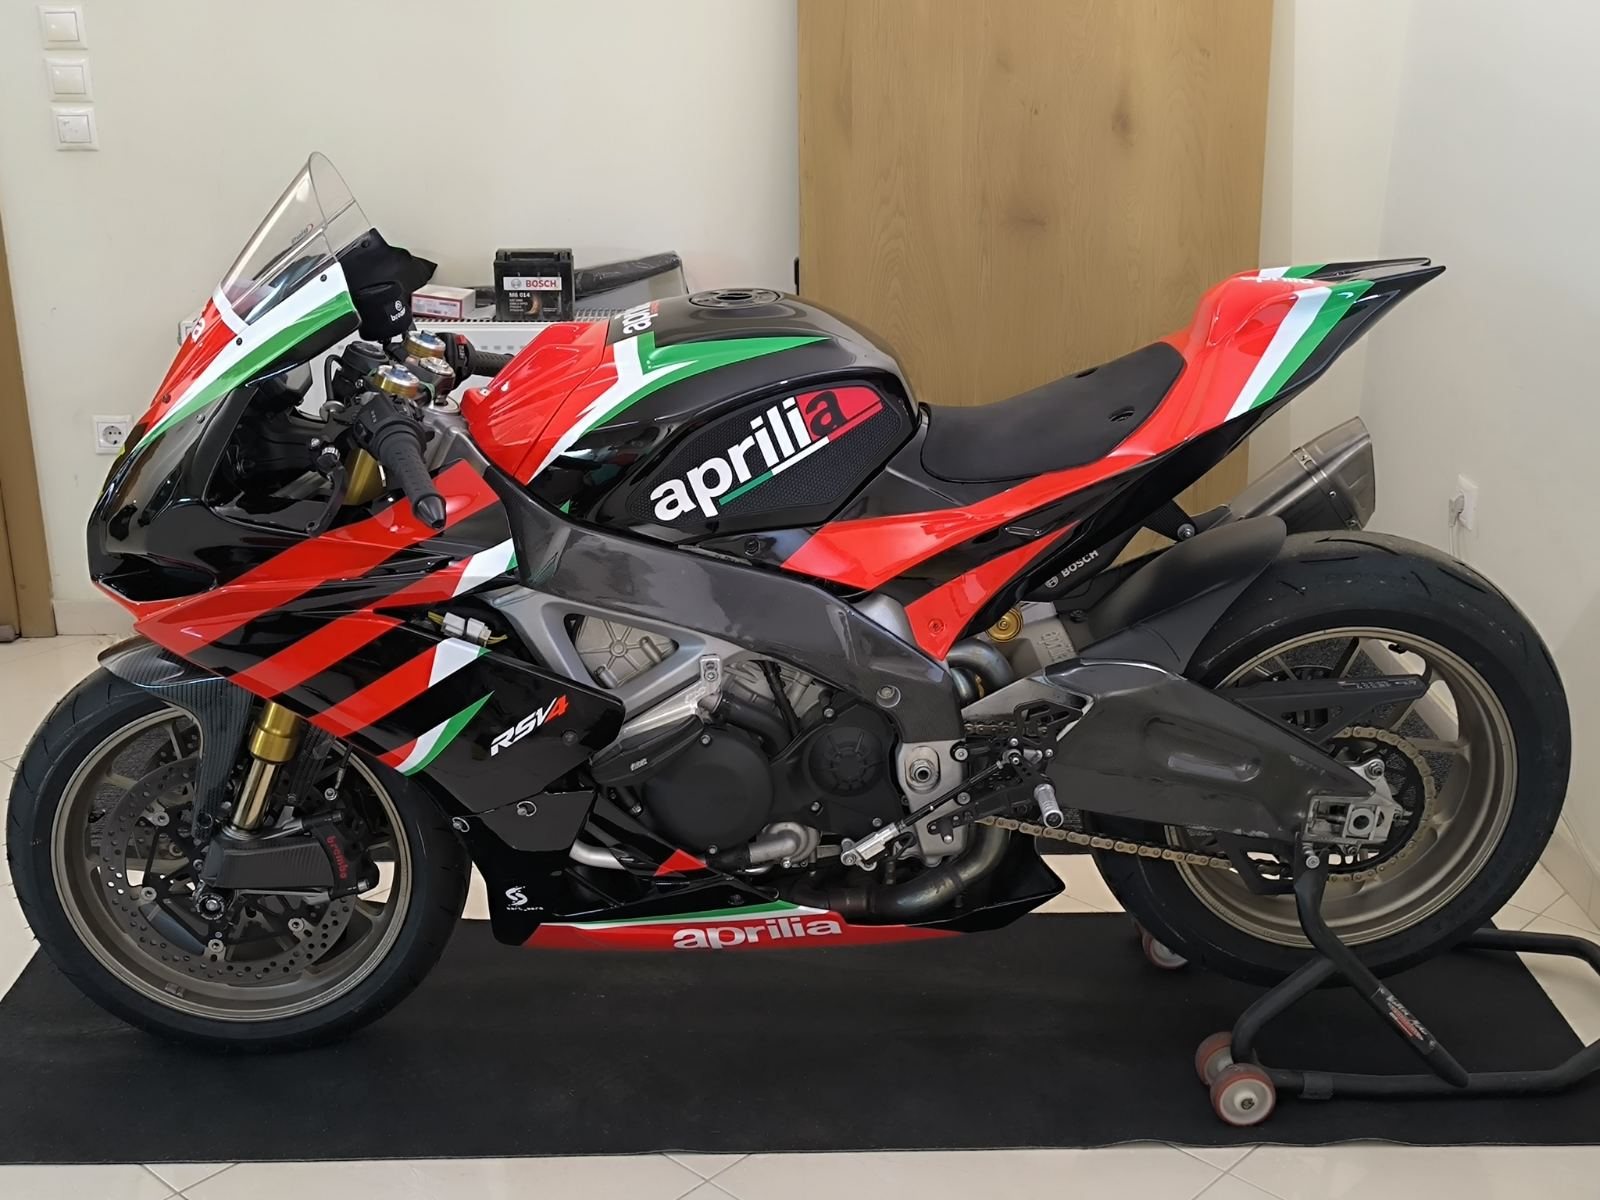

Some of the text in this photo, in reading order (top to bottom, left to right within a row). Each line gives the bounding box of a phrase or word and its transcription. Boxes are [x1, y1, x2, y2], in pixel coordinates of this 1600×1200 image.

[525, 280, 557, 288] BOSCH
[650, 391, 849, 521] aprilia
[1060, 549, 1100, 578] BOSCH
[490, 694, 569, 757] RSV4
[326, 835, 349, 880] brembo
[672, 917, 843, 949] aprilia
